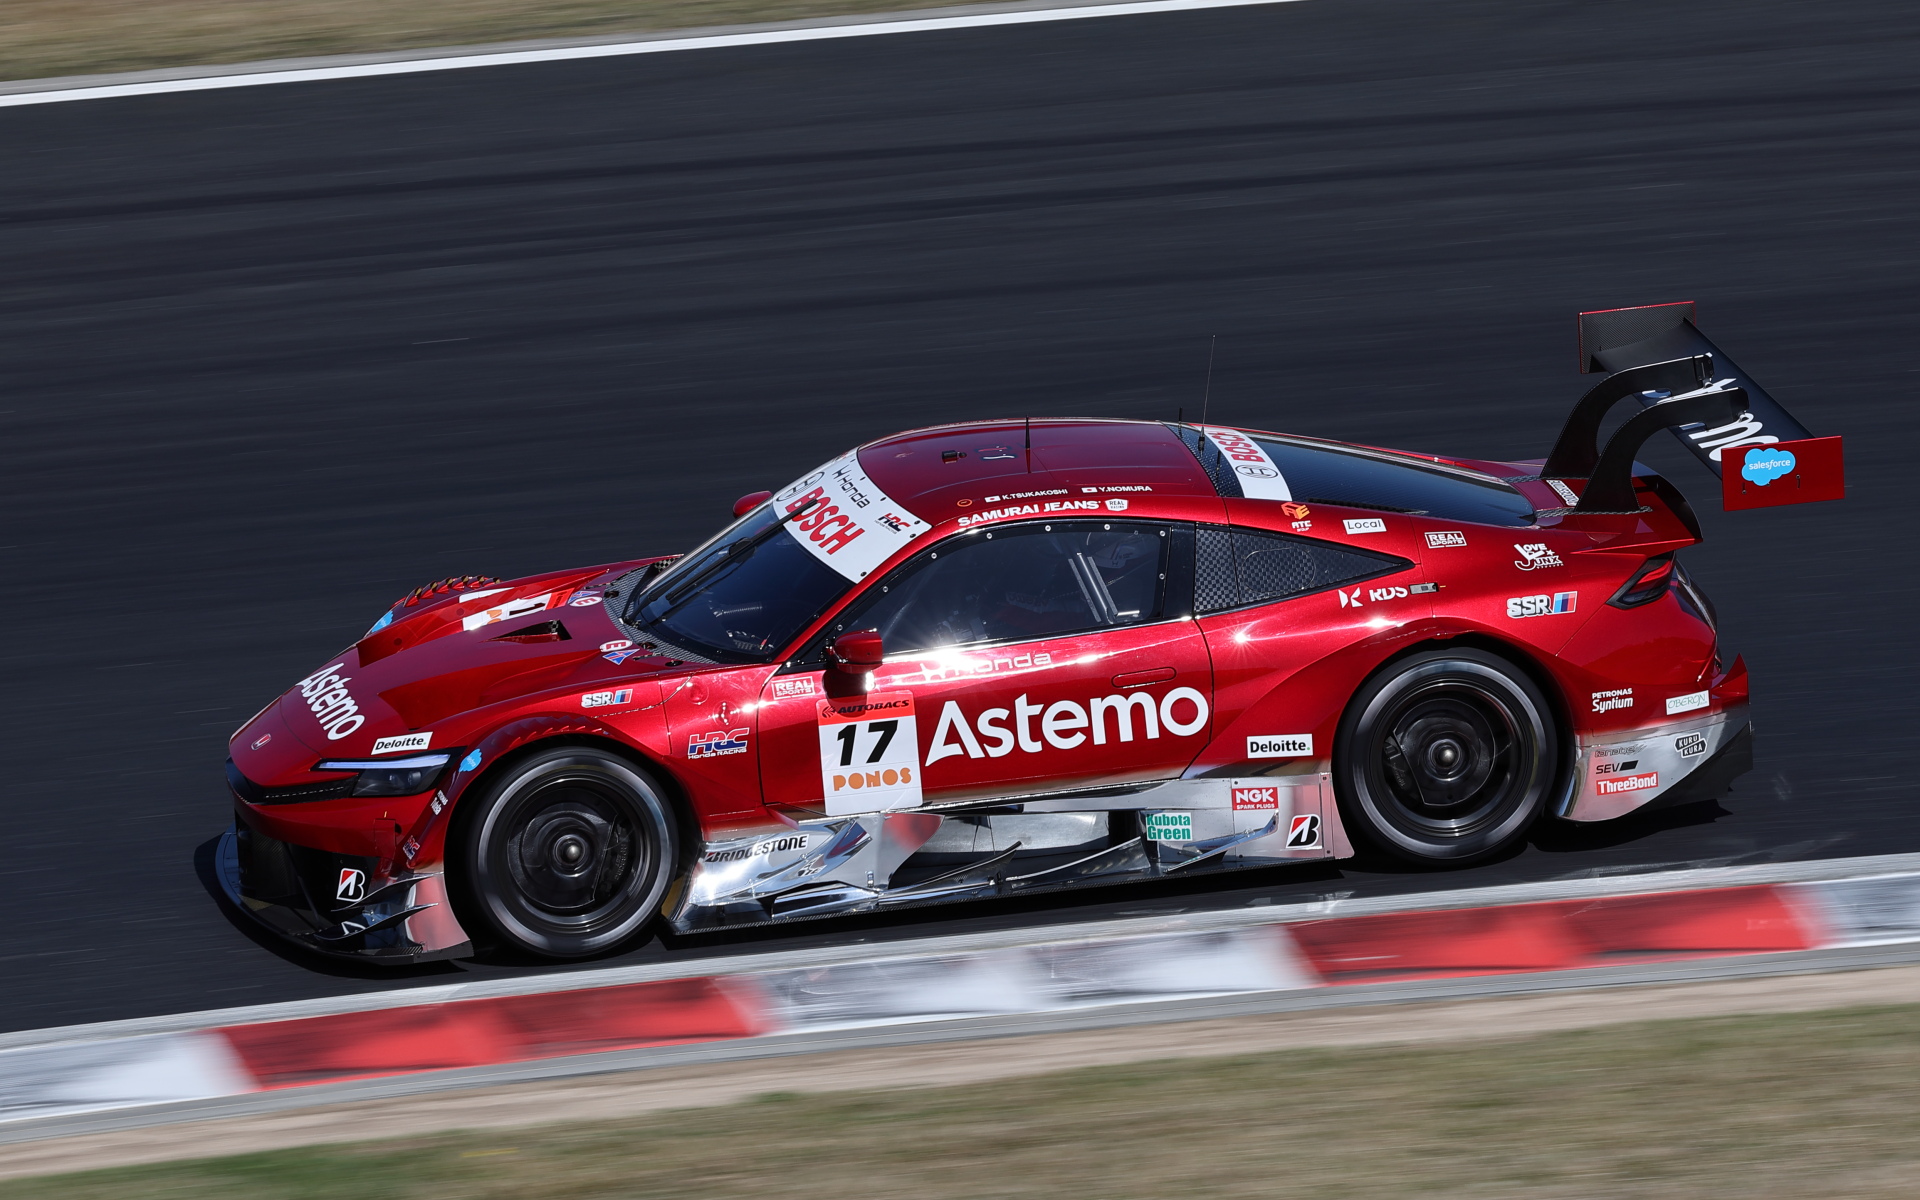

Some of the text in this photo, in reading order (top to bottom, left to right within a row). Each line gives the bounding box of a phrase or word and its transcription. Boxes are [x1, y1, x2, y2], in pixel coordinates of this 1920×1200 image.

[748, 458, 791, 471] salesforce
[837, 474, 871, 509] Honda
[1002, 488, 1068, 500] K.TSUKAKOSHI
[1098, 485, 1152, 493] Y.NOMURA
[785, 486, 865, 555] BOSCH
[957, 499, 1100, 527] SAMURAI JEANS
[1347, 519, 1381, 531] Local
[1428, 533, 1464, 541] REAL
[1507, 595, 1551, 618] SSR
[775, 679, 814, 691] REAL
[776, 687, 813, 697] SPORTS
[296, 662, 365, 741] Astemo
[581, 692, 615, 708] SSR
[1591, 688, 1633, 700] PETRONAS
[837, 699, 910, 714] AUTOBACS
[1592, 697, 1634, 714] Syntium
[925, 686, 1209, 767] Astemo
[375, 736, 427, 751] Deloitte.
[688, 727, 750, 755] HRC
[837, 720, 899, 767] 17
[1249, 739, 1311, 753] Deloitte.
[1679, 734, 1699, 748] KURU
[687, 747, 747, 760] Honda RACING
[1683, 743, 1703, 756] KURA
[1595, 762, 1620, 775] SEV
[833, 767, 912, 792] PONOS
[1597, 773, 1657, 794] ThreeBond
[1235, 788, 1275, 804] NGK
[1147, 813, 1191, 827] Kubota
[1147, 825, 1191, 840] Green
[704, 836, 808, 863] BRIDGESTONE
